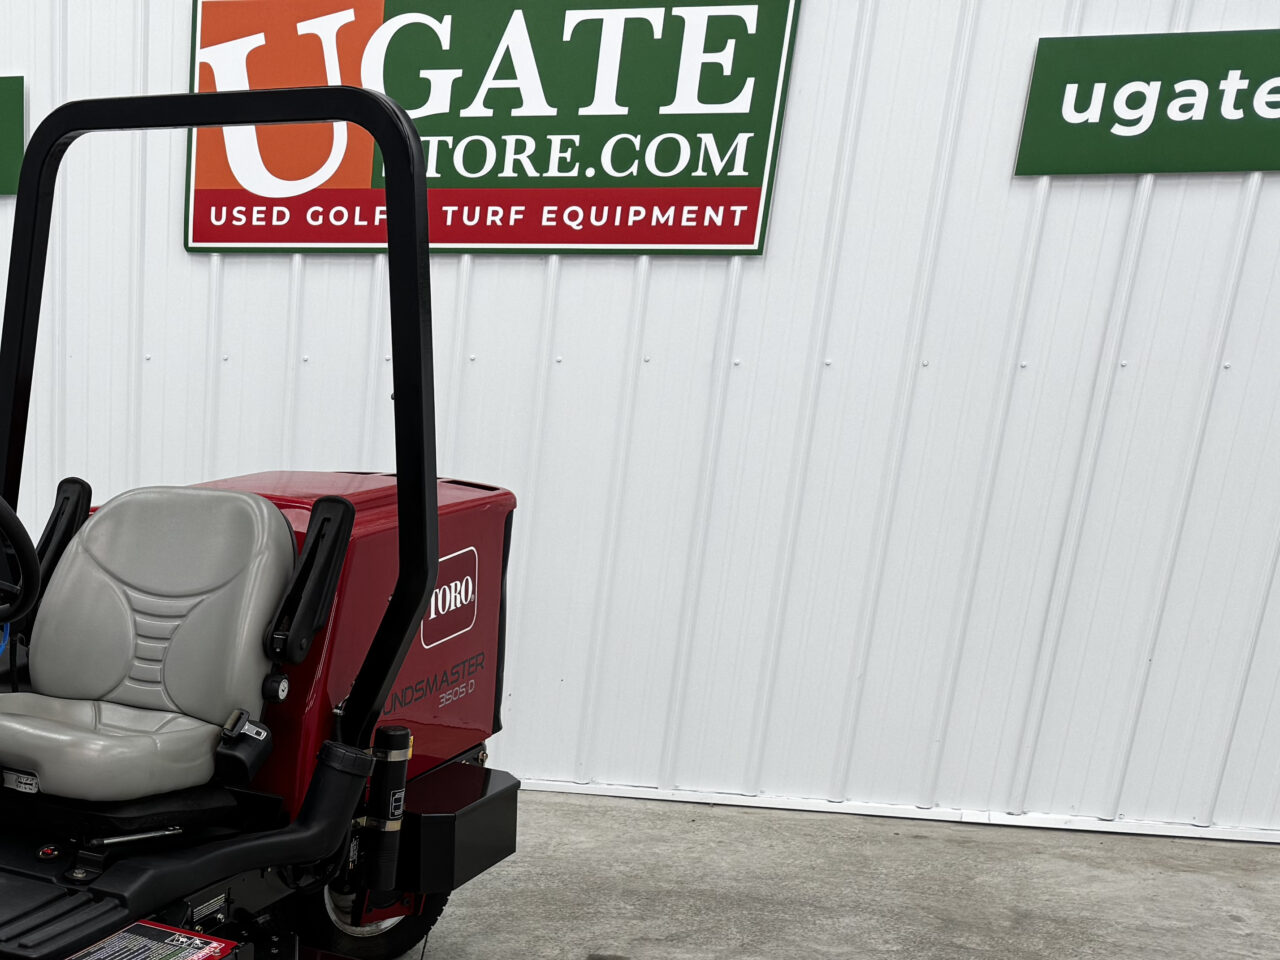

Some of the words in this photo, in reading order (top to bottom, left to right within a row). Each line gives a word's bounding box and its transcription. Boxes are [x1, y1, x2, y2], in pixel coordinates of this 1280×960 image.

[382, 132, 754, 179] TORE.COM
[210, 206, 290, 226] USED
[306, 206, 388, 226] GOLF
[442, 206, 525, 226] TURF
[541, 205, 748, 230] EQUIPMENT
[383, 651, 485, 716] UNDSMASTER
[438, 682, 467, 708] 3505
